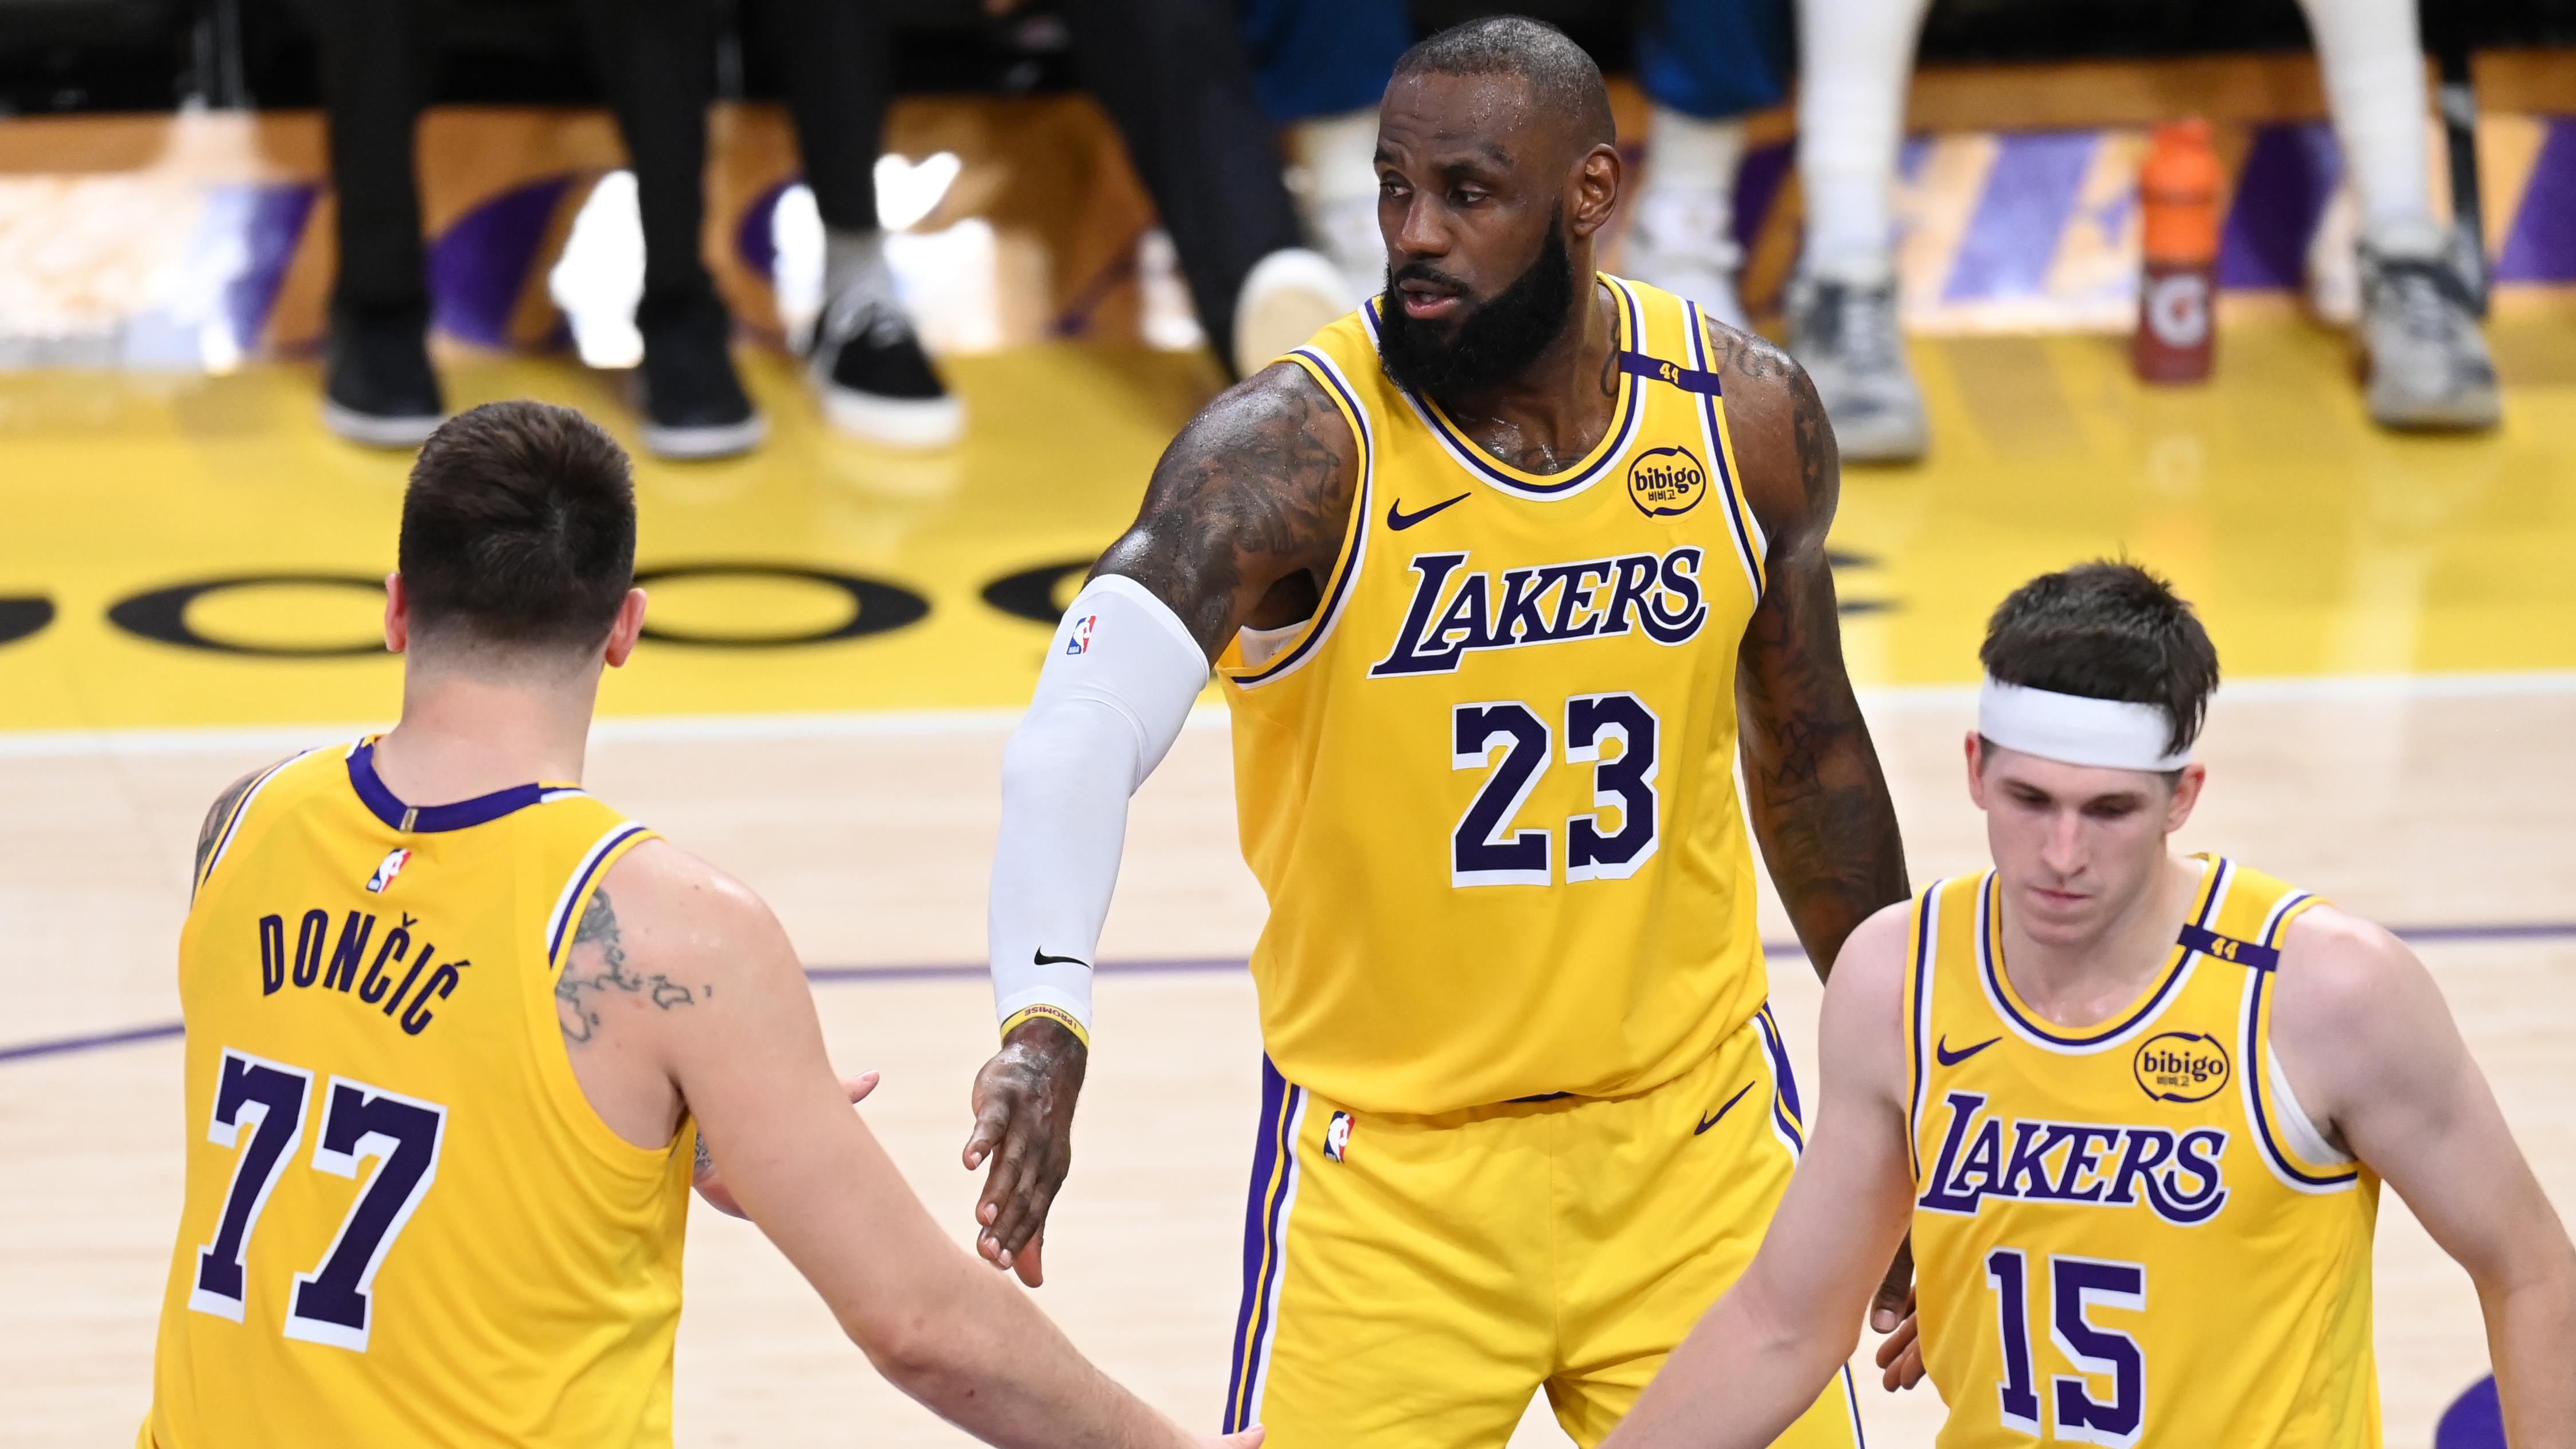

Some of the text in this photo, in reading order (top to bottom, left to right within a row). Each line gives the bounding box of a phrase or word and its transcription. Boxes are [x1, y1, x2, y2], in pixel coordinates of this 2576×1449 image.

[1659, 363, 1679, 384] 44
[1634, 465, 1701, 494] bibigo
[1648, 489, 1676, 502] 비비고
[1366, 545, 1710, 679] LAKERS
[1451, 691, 1659, 888] 23
[259, 909, 471, 1036] DONČIĆ
[1024, 1006, 1073, 1026] PROMISE
[2144, 1050, 2223, 1082] bibigo
[188, 1045, 448, 1353] 77
[1917, 1090, 2231, 1228] LAKERS
[1986, 1247, 2145, 1448] 15
